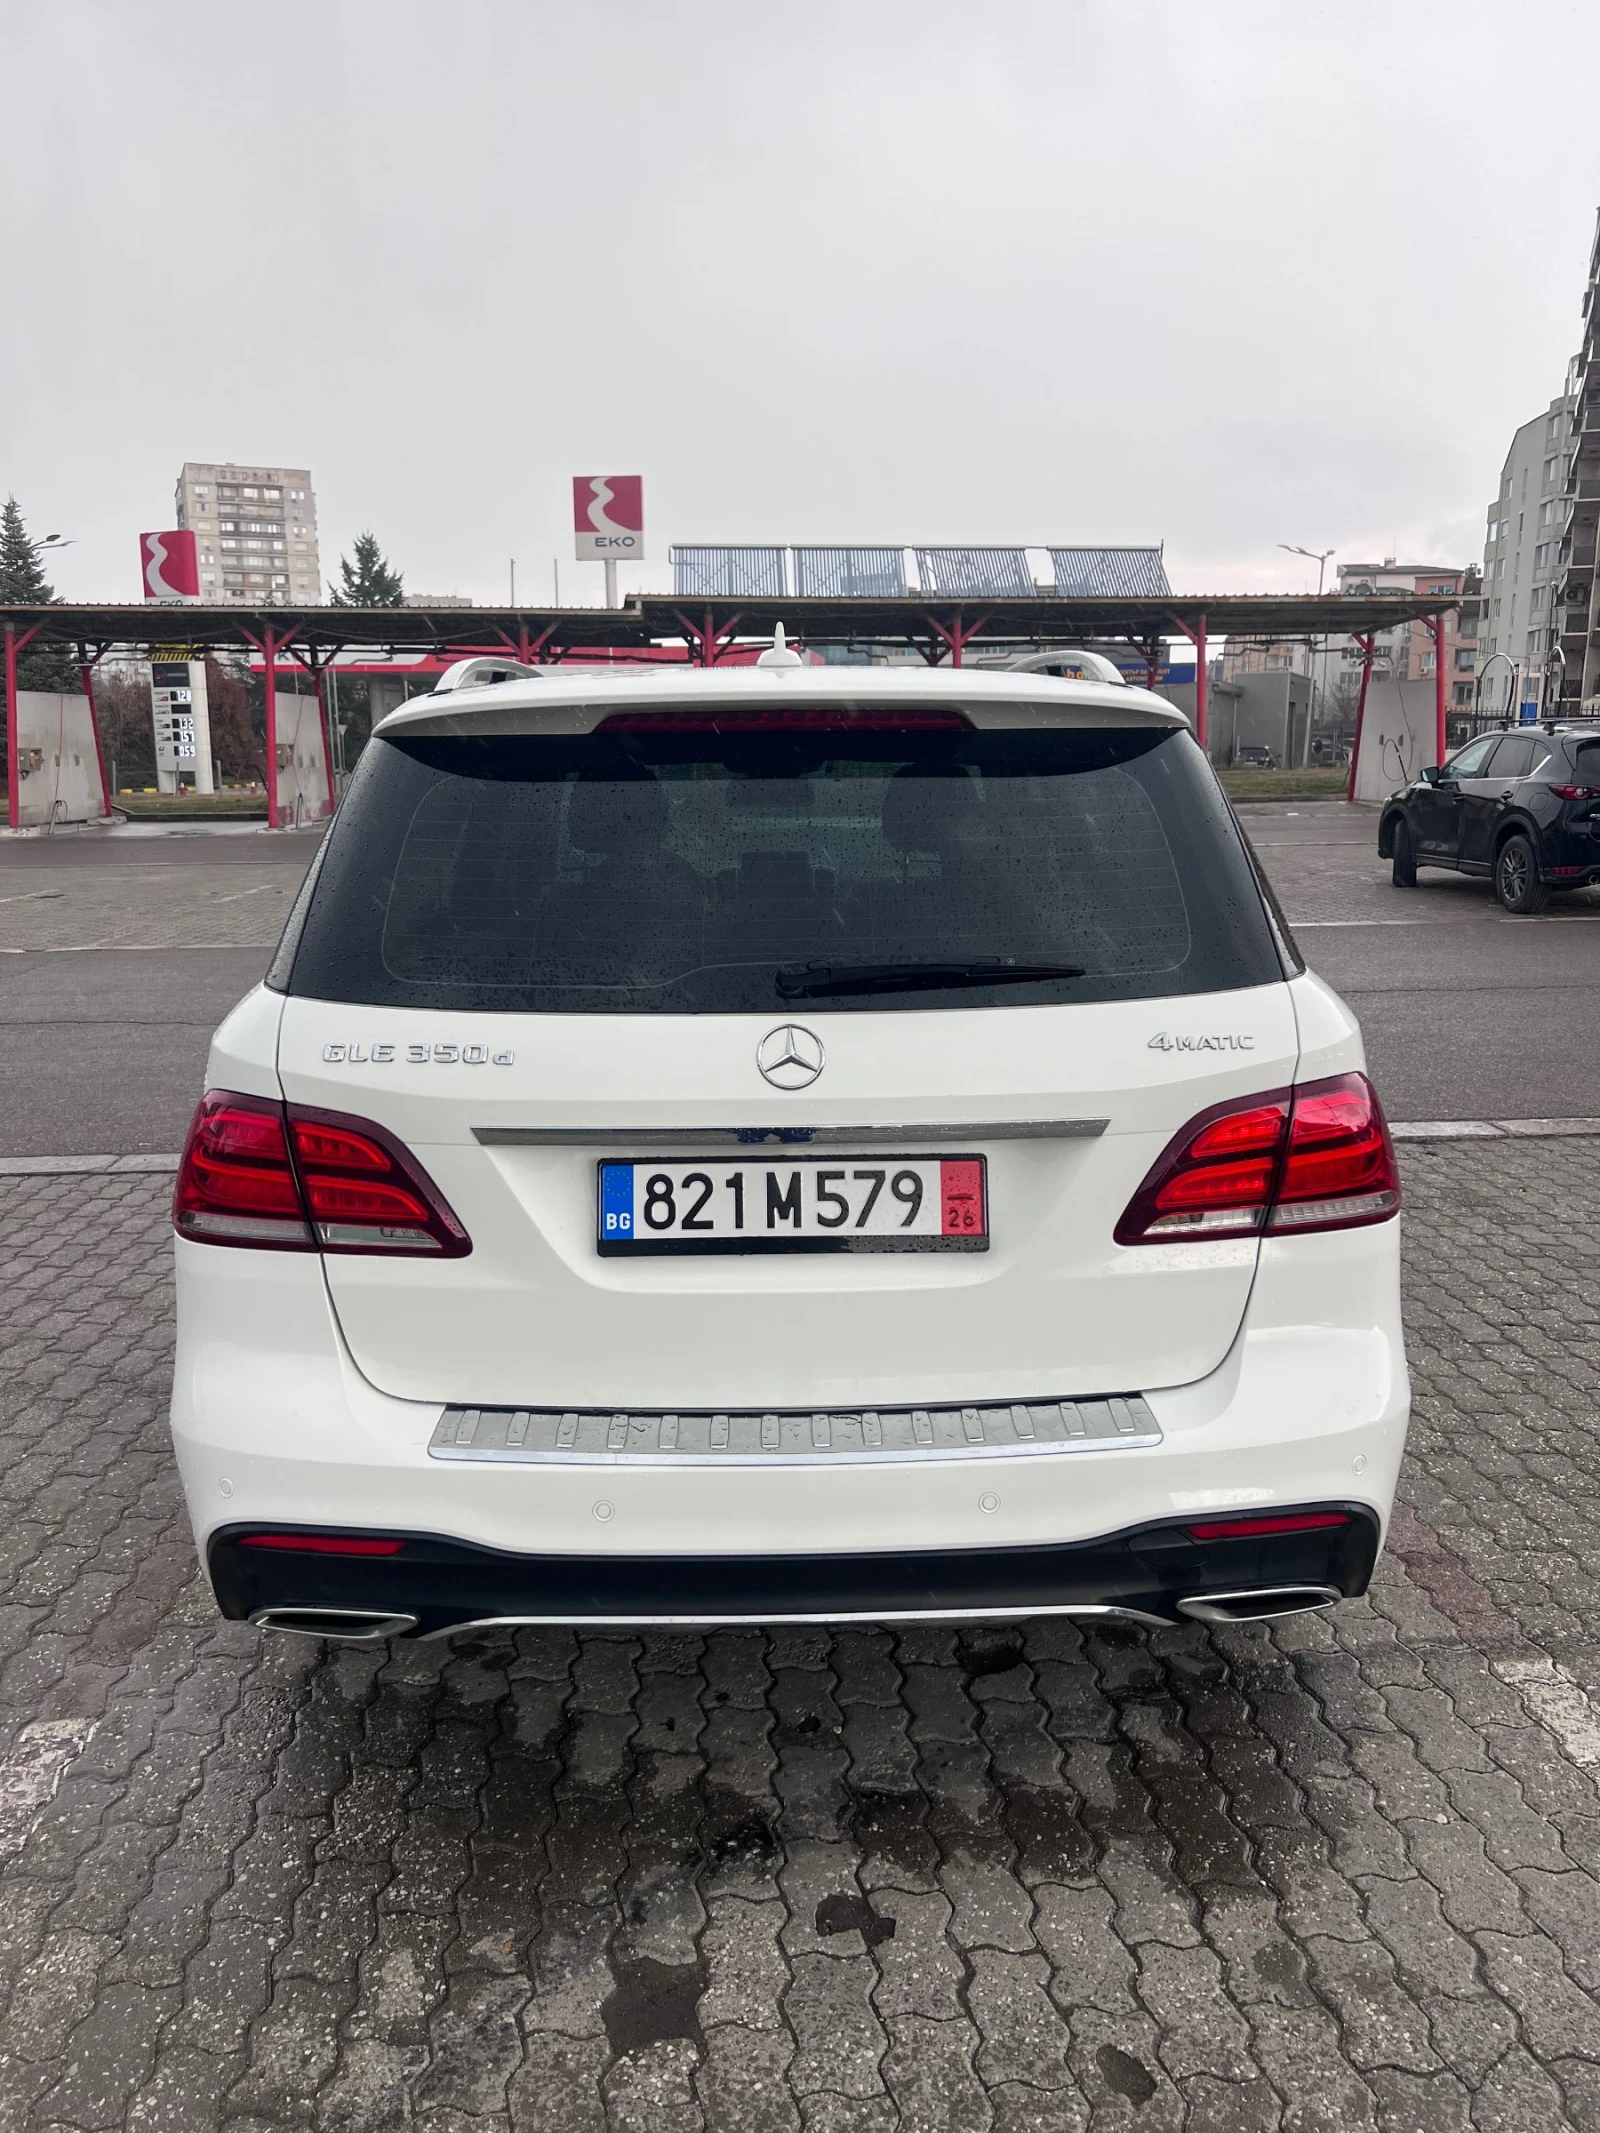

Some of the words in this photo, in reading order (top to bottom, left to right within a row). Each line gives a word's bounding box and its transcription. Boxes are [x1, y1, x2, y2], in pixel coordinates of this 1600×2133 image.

[595, 536, 636, 547] EKO
[1147, 1032, 1255, 1051] 4MATIC
[322, 1043, 396, 1063] GLE
[406, 1043, 514, 1066] 350d
[606, 1212, 631, 1230] BG
[948, 1207, 976, 1227] 26
